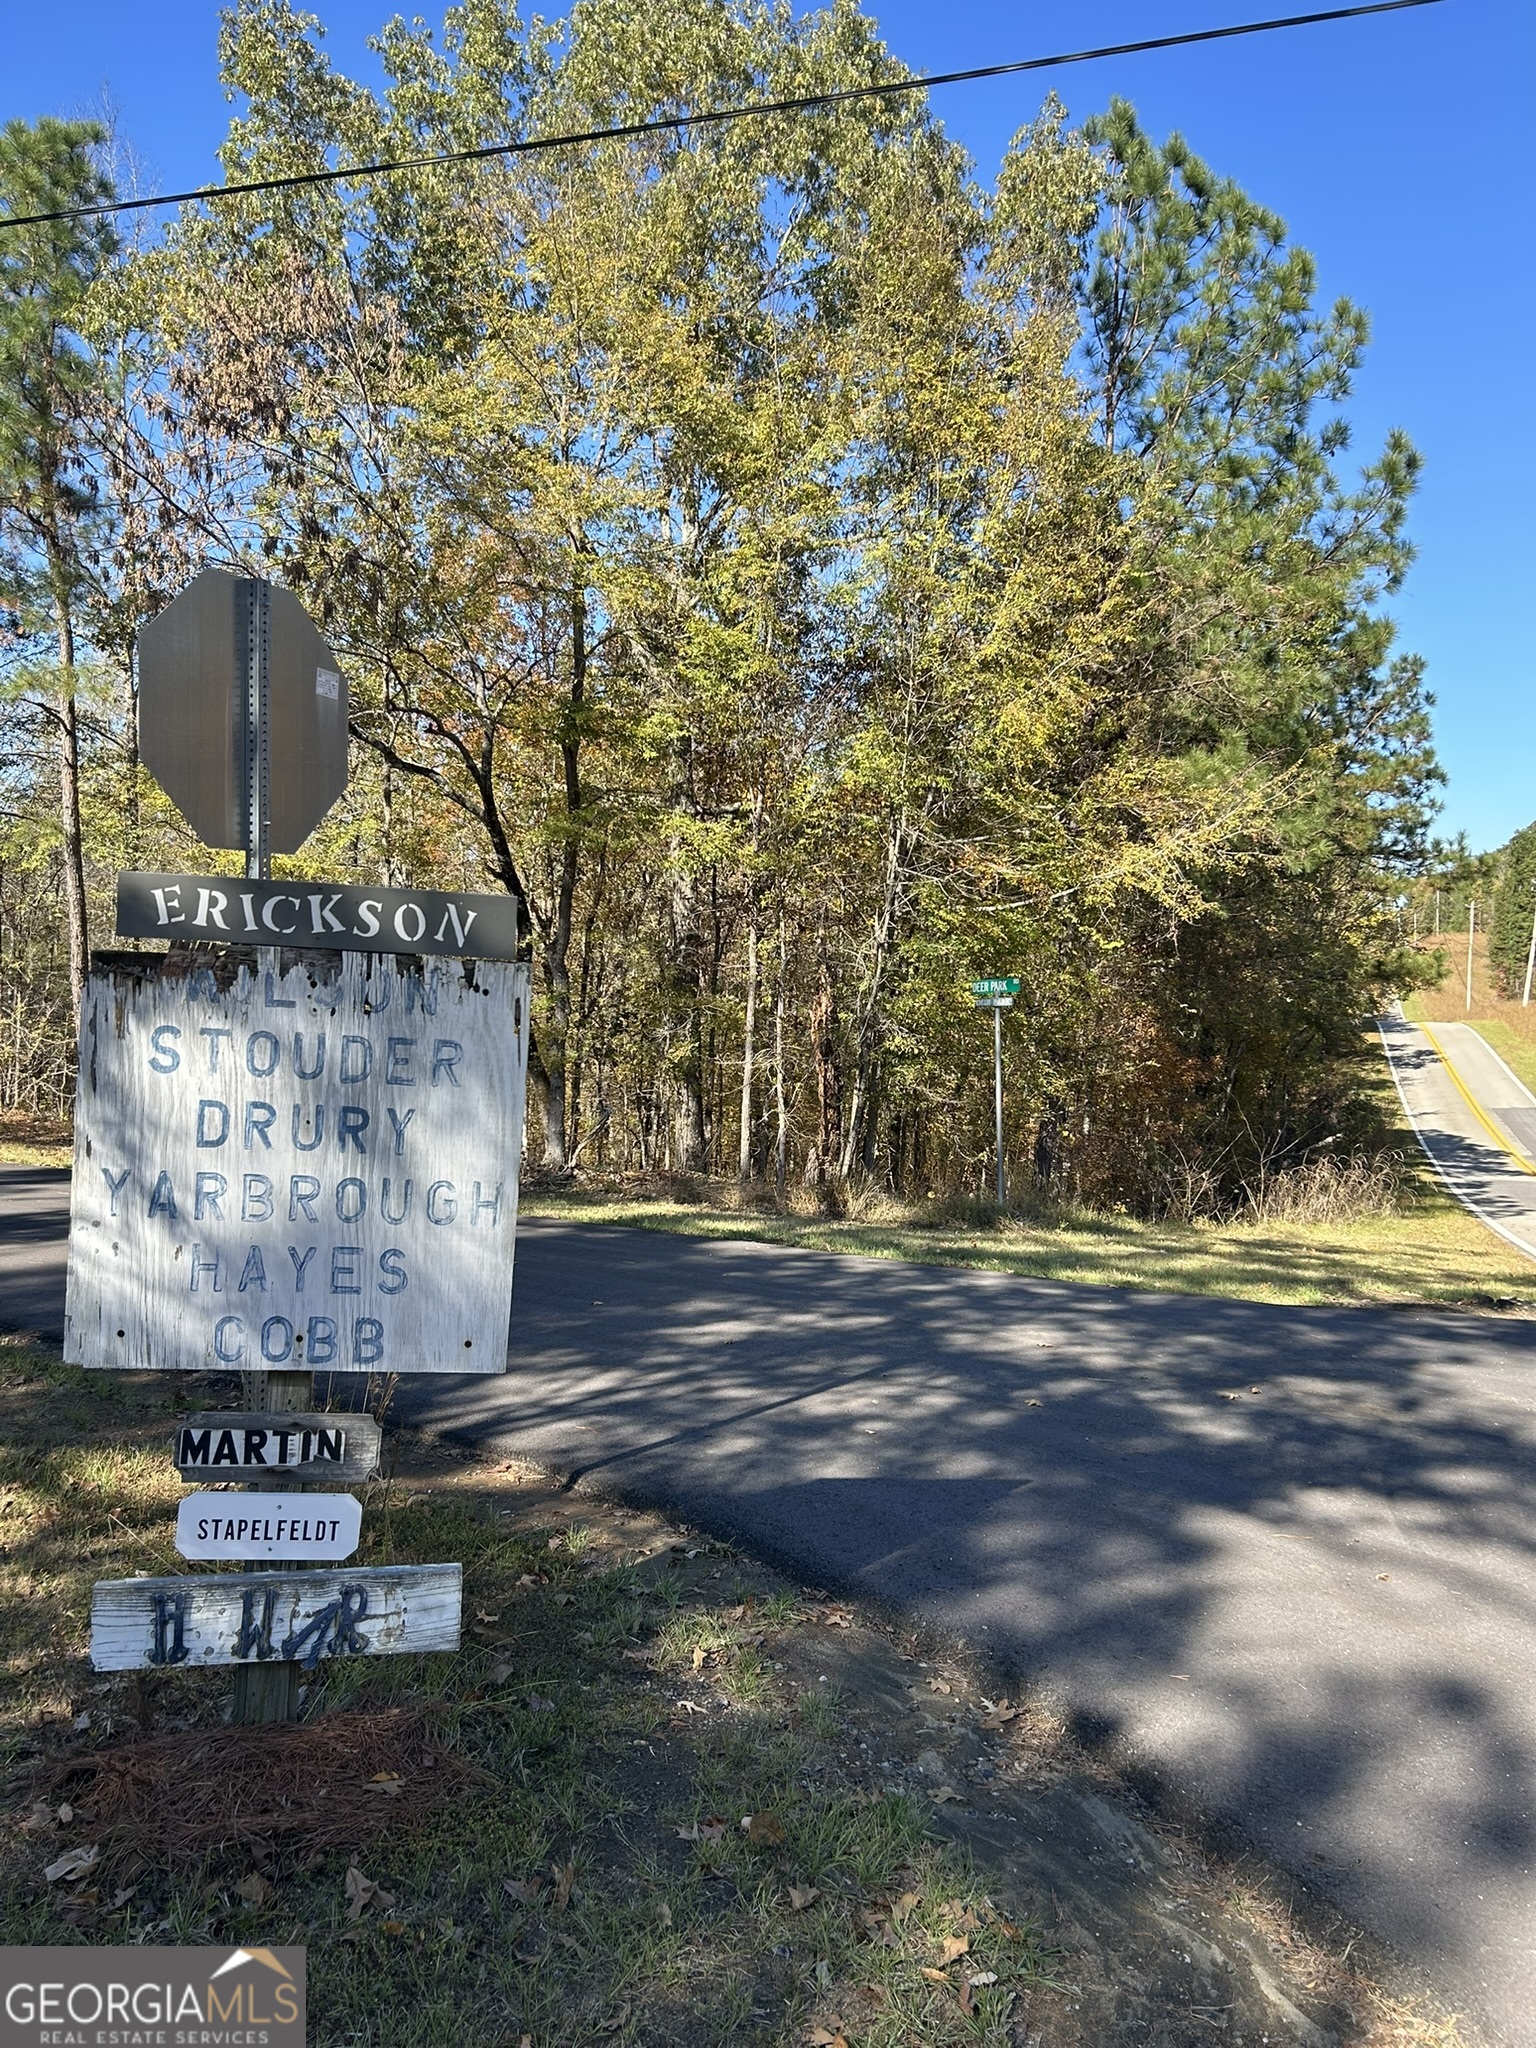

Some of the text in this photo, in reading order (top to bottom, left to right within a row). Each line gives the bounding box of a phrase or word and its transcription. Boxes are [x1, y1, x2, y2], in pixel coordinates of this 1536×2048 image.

[150, 884, 478, 948] ERICKSON
[972, 982, 989, 993] DEER
[990, 980, 1007, 992] PARK
[148, 1025, 464, 1088] STOUDER
[196, 1099, 416, 1157] DRURY
[100, 1167, 503, 1228] YARBROUGH
[189, 1243, 409, 1296] HAYES
[214, 1315, 385, 1364] COBB
[180, 1429, 343, 1466] MARTIN
[197, 1519, 341, 1542] STAPELFELDT
